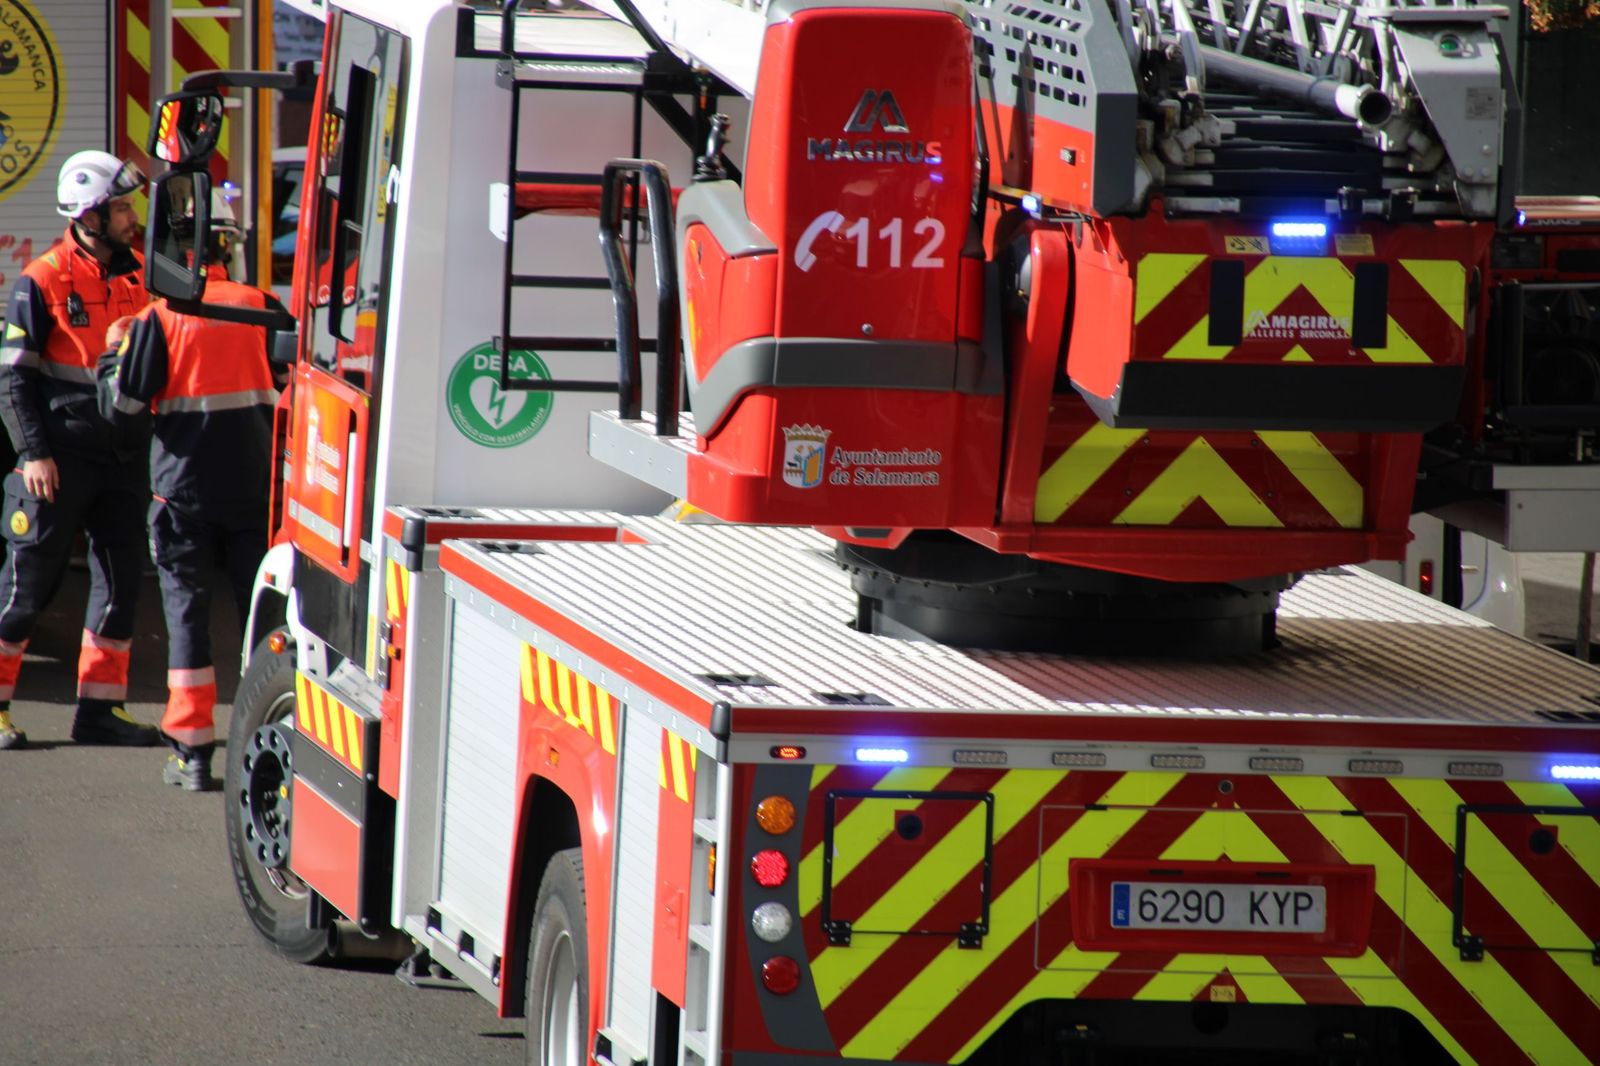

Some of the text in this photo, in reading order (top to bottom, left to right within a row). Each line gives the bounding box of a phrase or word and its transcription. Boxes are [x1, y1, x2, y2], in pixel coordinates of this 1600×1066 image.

[807, 137, 943, 165] MAGIRUS
[846, 217, 946, 268] 112
[1271, 315, 1349, 329] MAGIRUS
[474, 354, 528, 373] DEA
[830, 446, 942, 468] Ayuntamiento
[829, 466, 940, 486] de Salamanca
[1137, 889, 1226, 924] 6290
[1249, 890, 1314, 926] KYP
